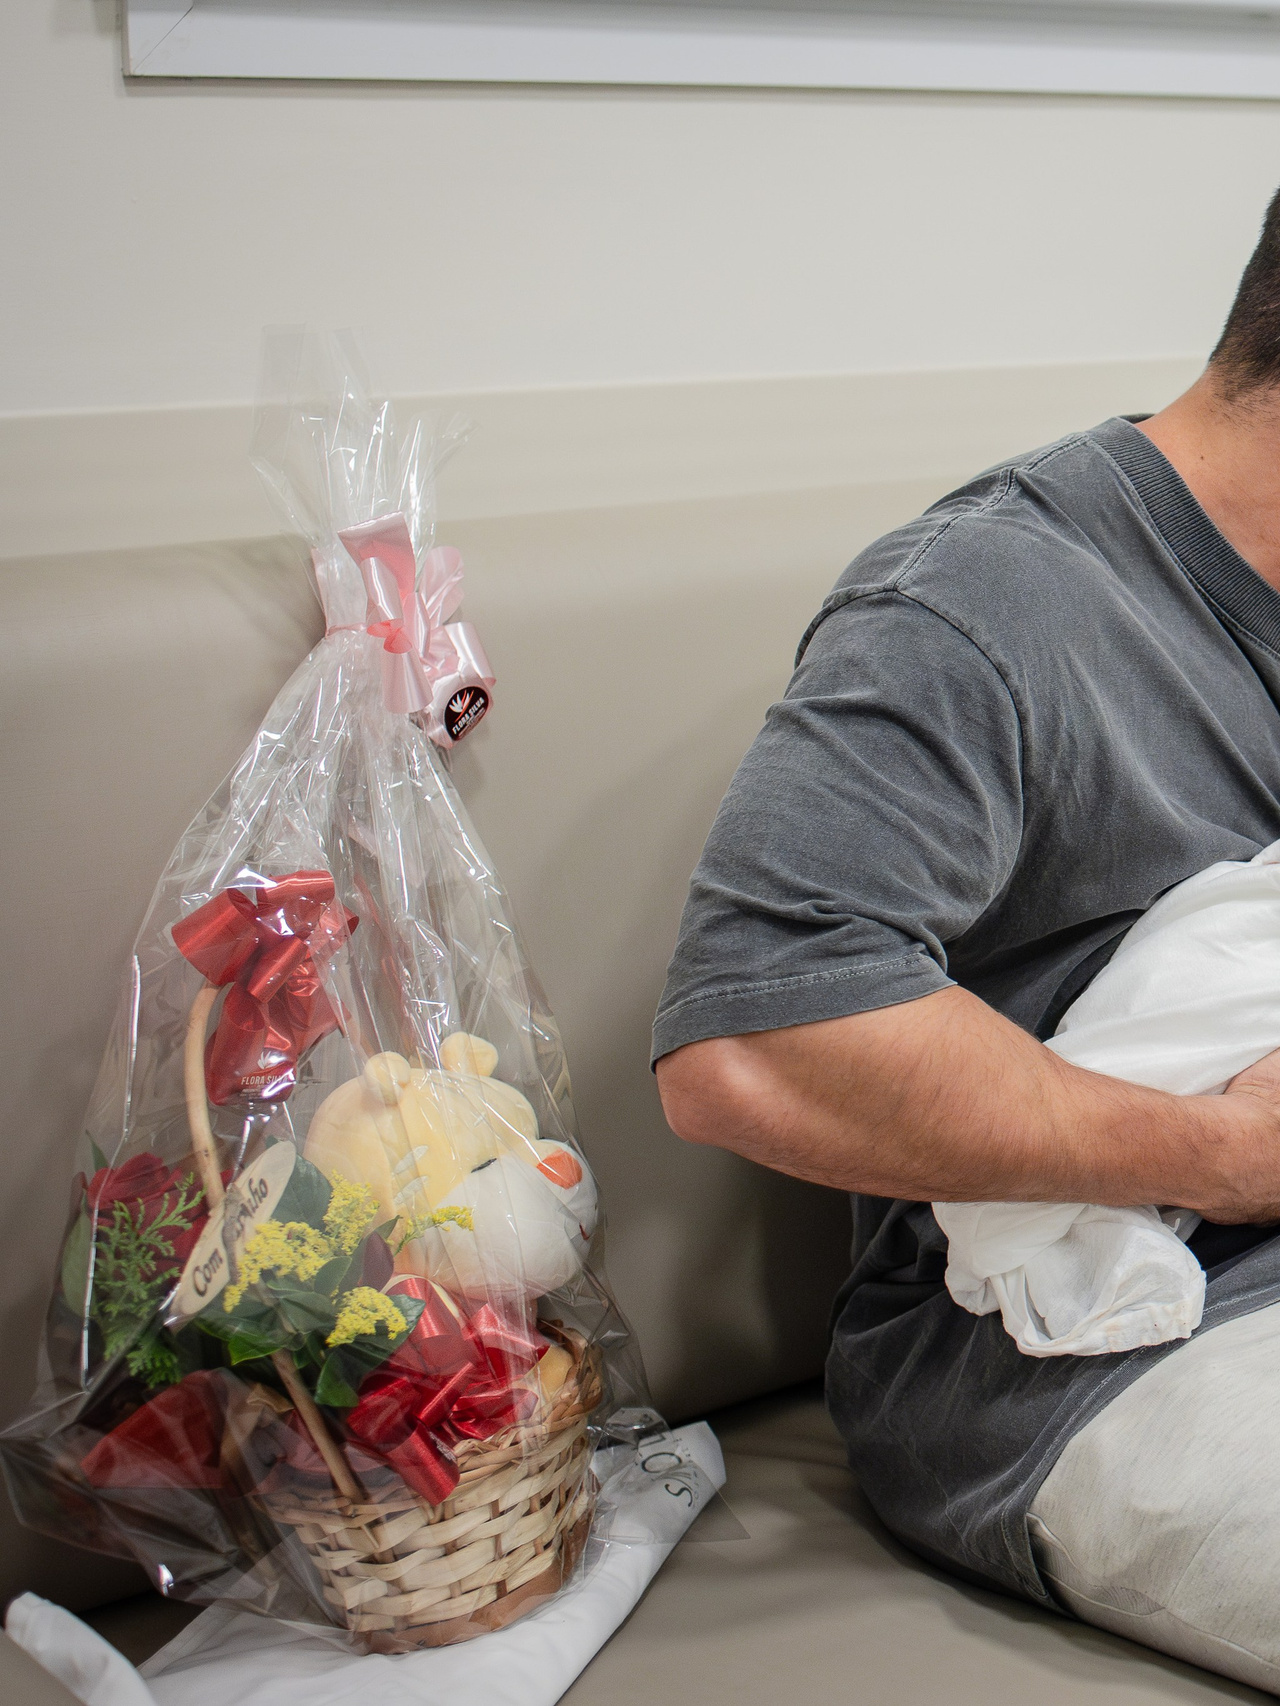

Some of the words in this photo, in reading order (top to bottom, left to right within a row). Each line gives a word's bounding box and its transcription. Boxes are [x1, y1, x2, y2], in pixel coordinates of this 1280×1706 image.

[452, 713, 470, 735] FLORA
[468, 697, 485, 717] SILVA
[241, 1075, 265, 1085] FLORA
[192, 1248, 224, 1298] Com
